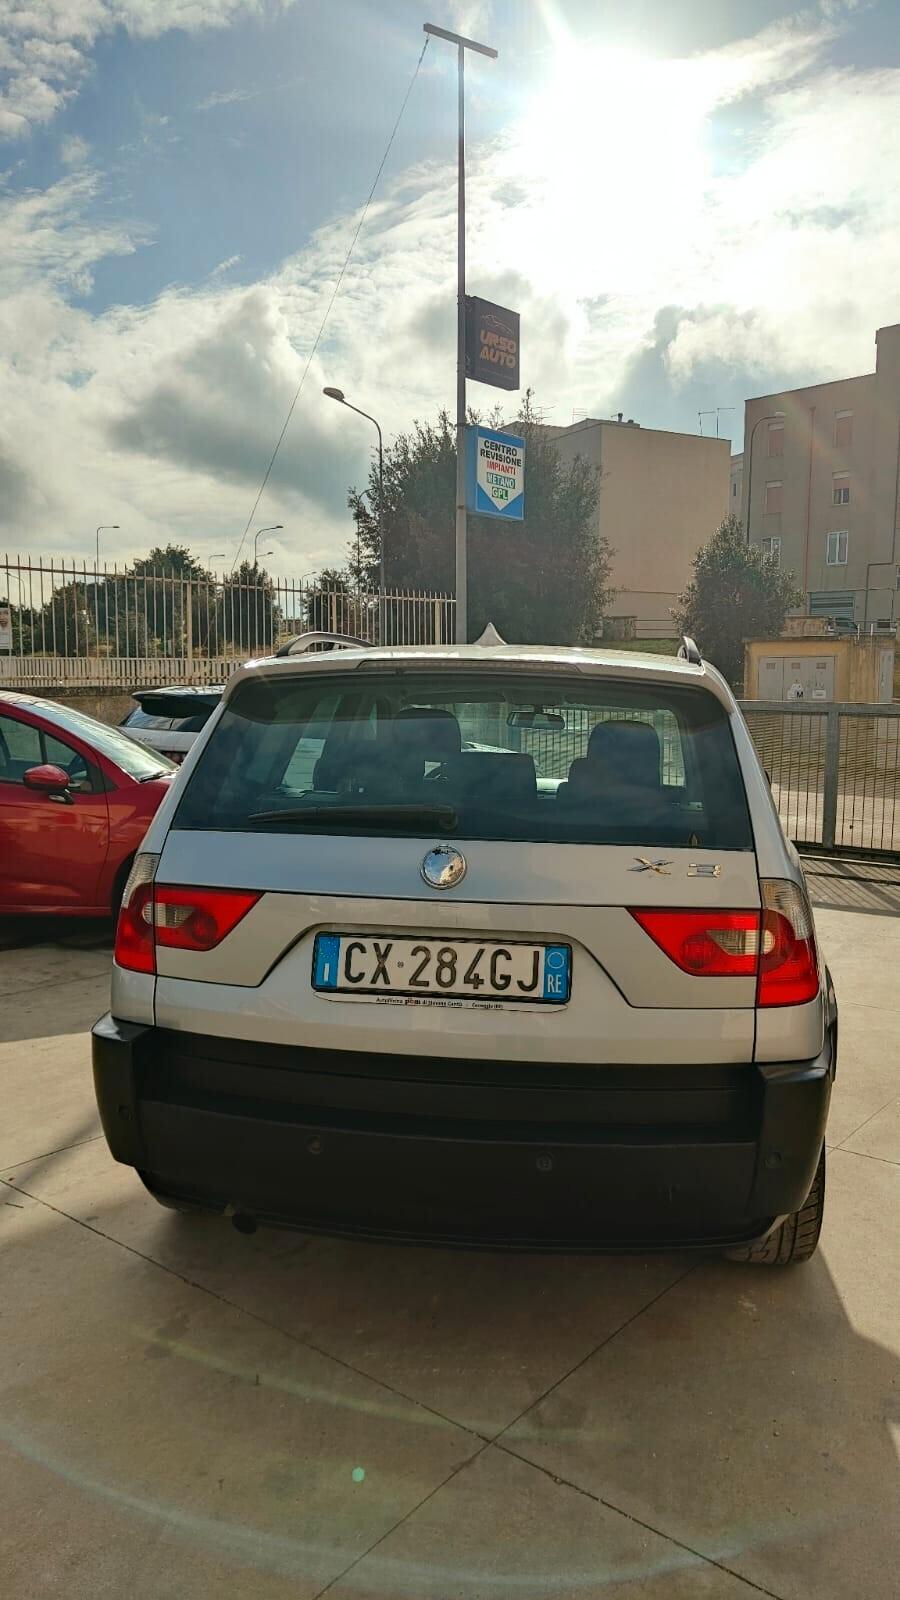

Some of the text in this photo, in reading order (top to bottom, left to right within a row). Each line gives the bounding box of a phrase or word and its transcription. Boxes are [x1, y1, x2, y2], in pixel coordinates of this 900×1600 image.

[480, 330, 516, 354] URSO
[480, 344, 516, 369] AUTO
[480, 448, 522, 468] REVISIONE
[484, 440, 517, 457] CENTRO
[487, 460, 516, 475] IMPIANTI
[492, 488, 508, 500] GPL
[547, 973, 562, 994] RE
